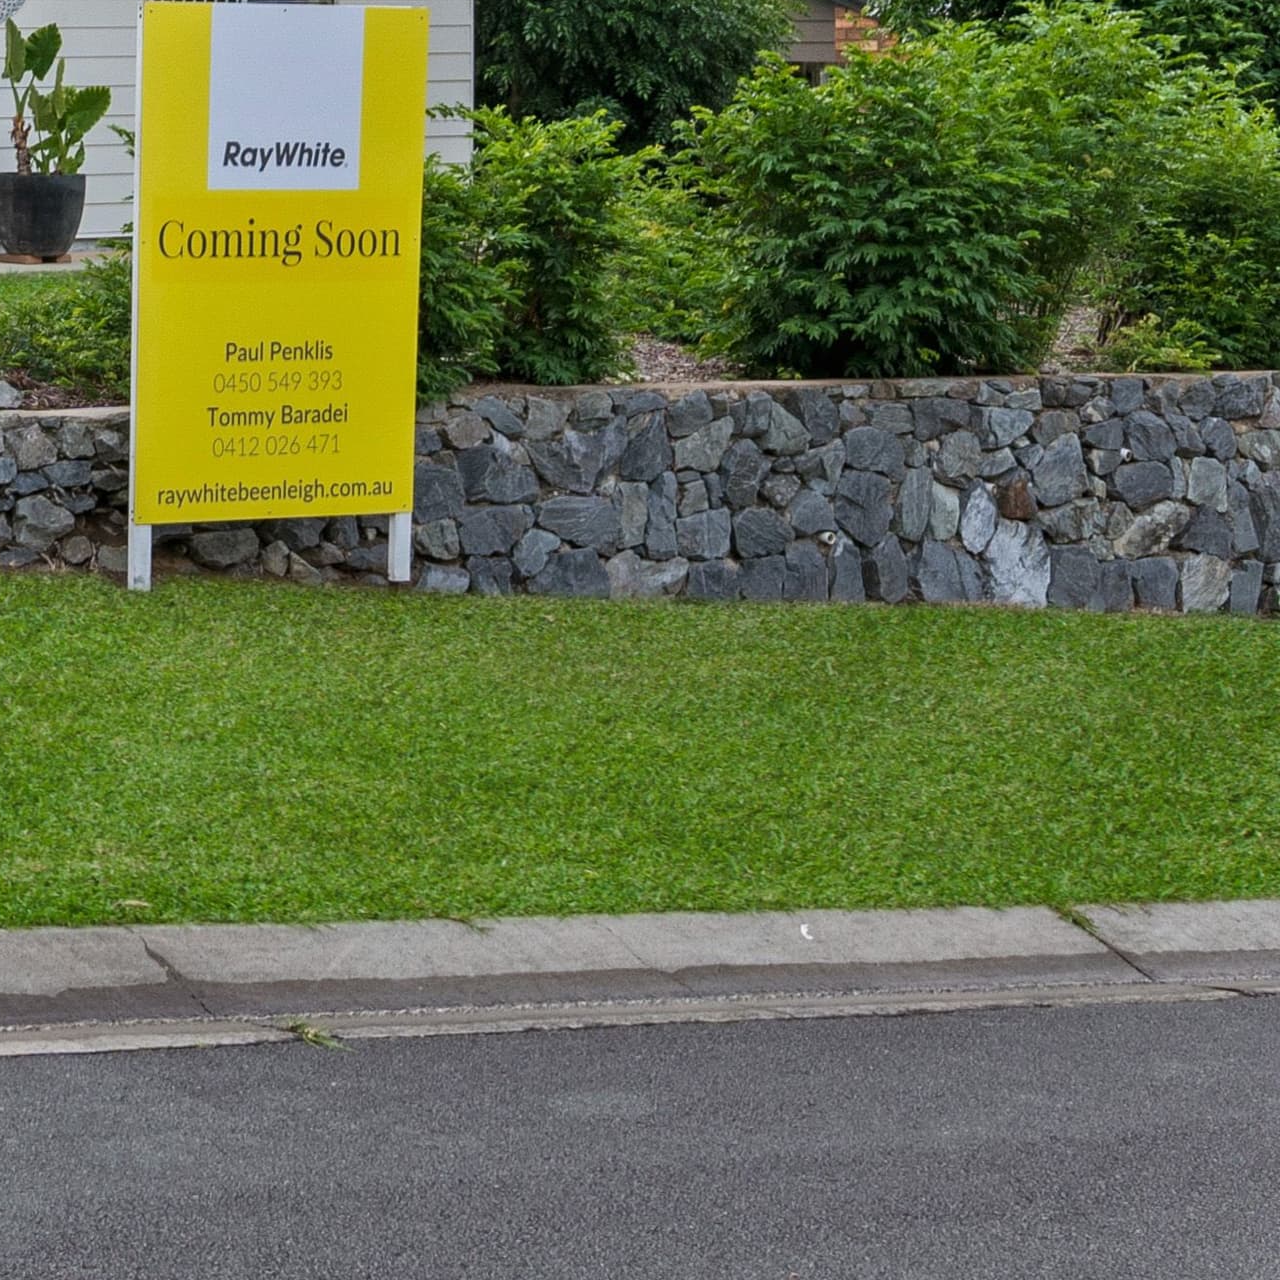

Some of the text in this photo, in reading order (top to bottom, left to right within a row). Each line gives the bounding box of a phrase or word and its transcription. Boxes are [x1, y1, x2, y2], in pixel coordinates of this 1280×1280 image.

[158, 218, 401, 267] Coming Soon
[225, 339, 333, 362] Paul Penklis
[213, 369, 343, 393] 0450 549 393
[207, 402, 349, 429] Tommy Baradei
[212, 433, 340, 458] 0412 026 471
[157, 478, 394, 509] raywhitebeenleigh.com.au
